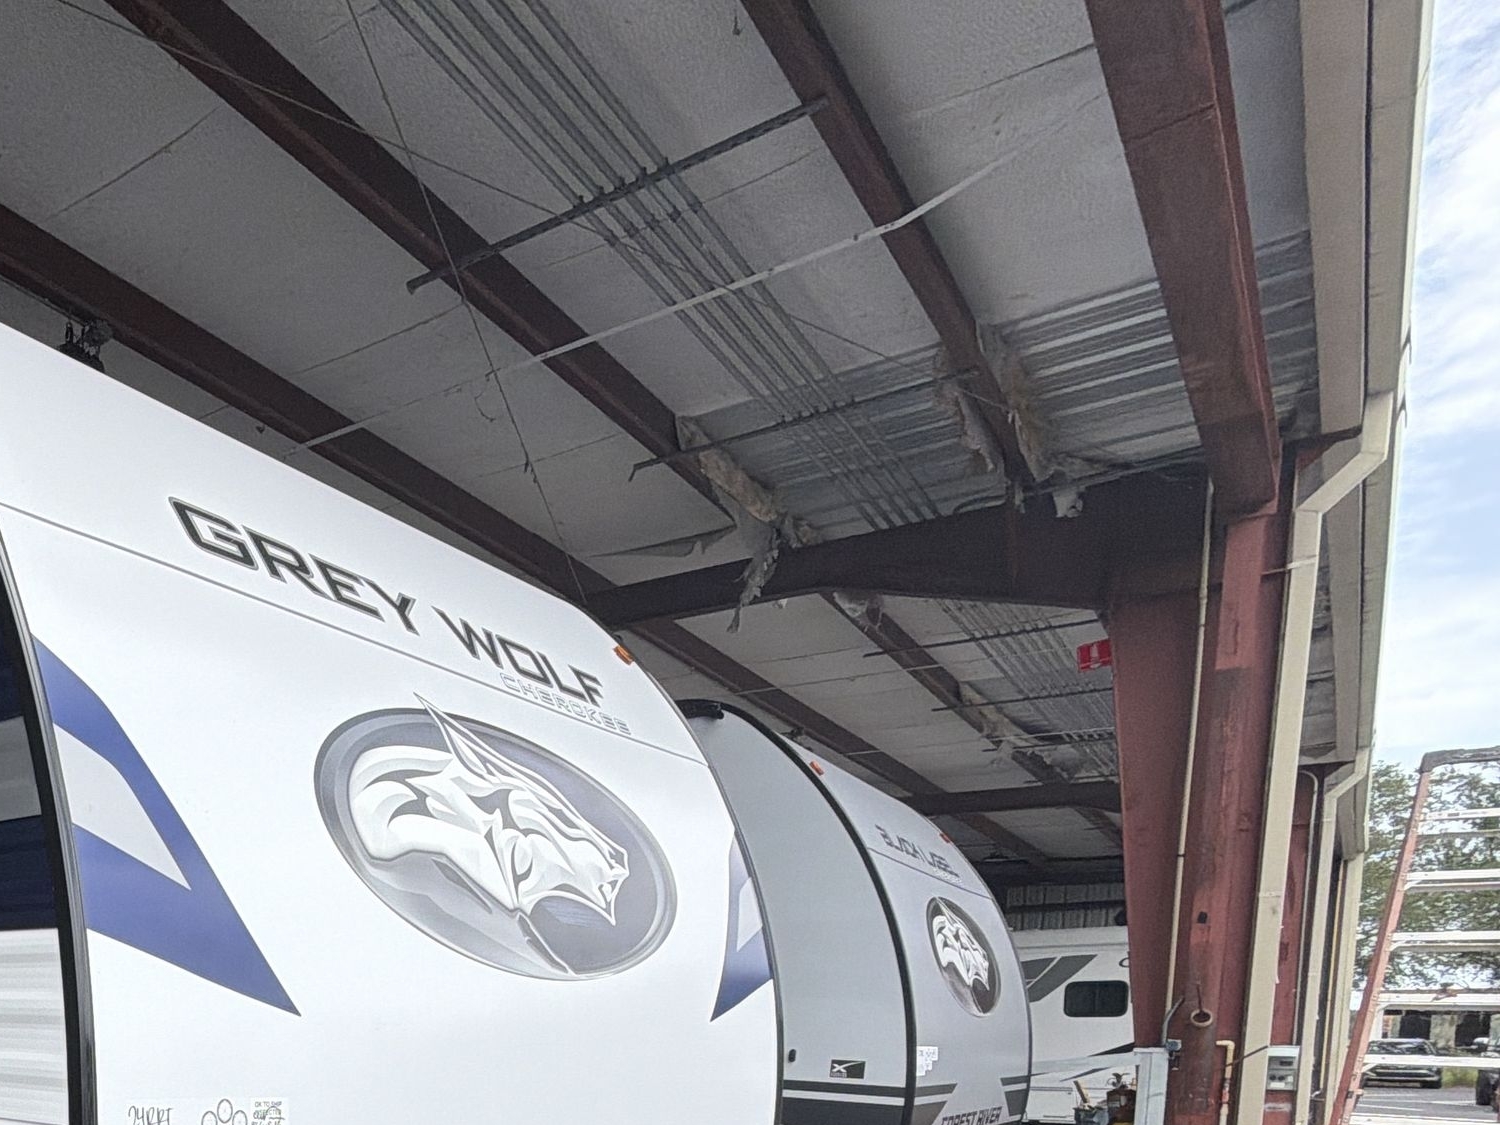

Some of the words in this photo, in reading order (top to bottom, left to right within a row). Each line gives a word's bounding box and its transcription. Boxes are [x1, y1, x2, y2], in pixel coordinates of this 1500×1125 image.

[167, 495, 420, 636] GREY
[431, 605, 605, 709] WOLF
[500, 671, 633, 736] CHEROKEE
